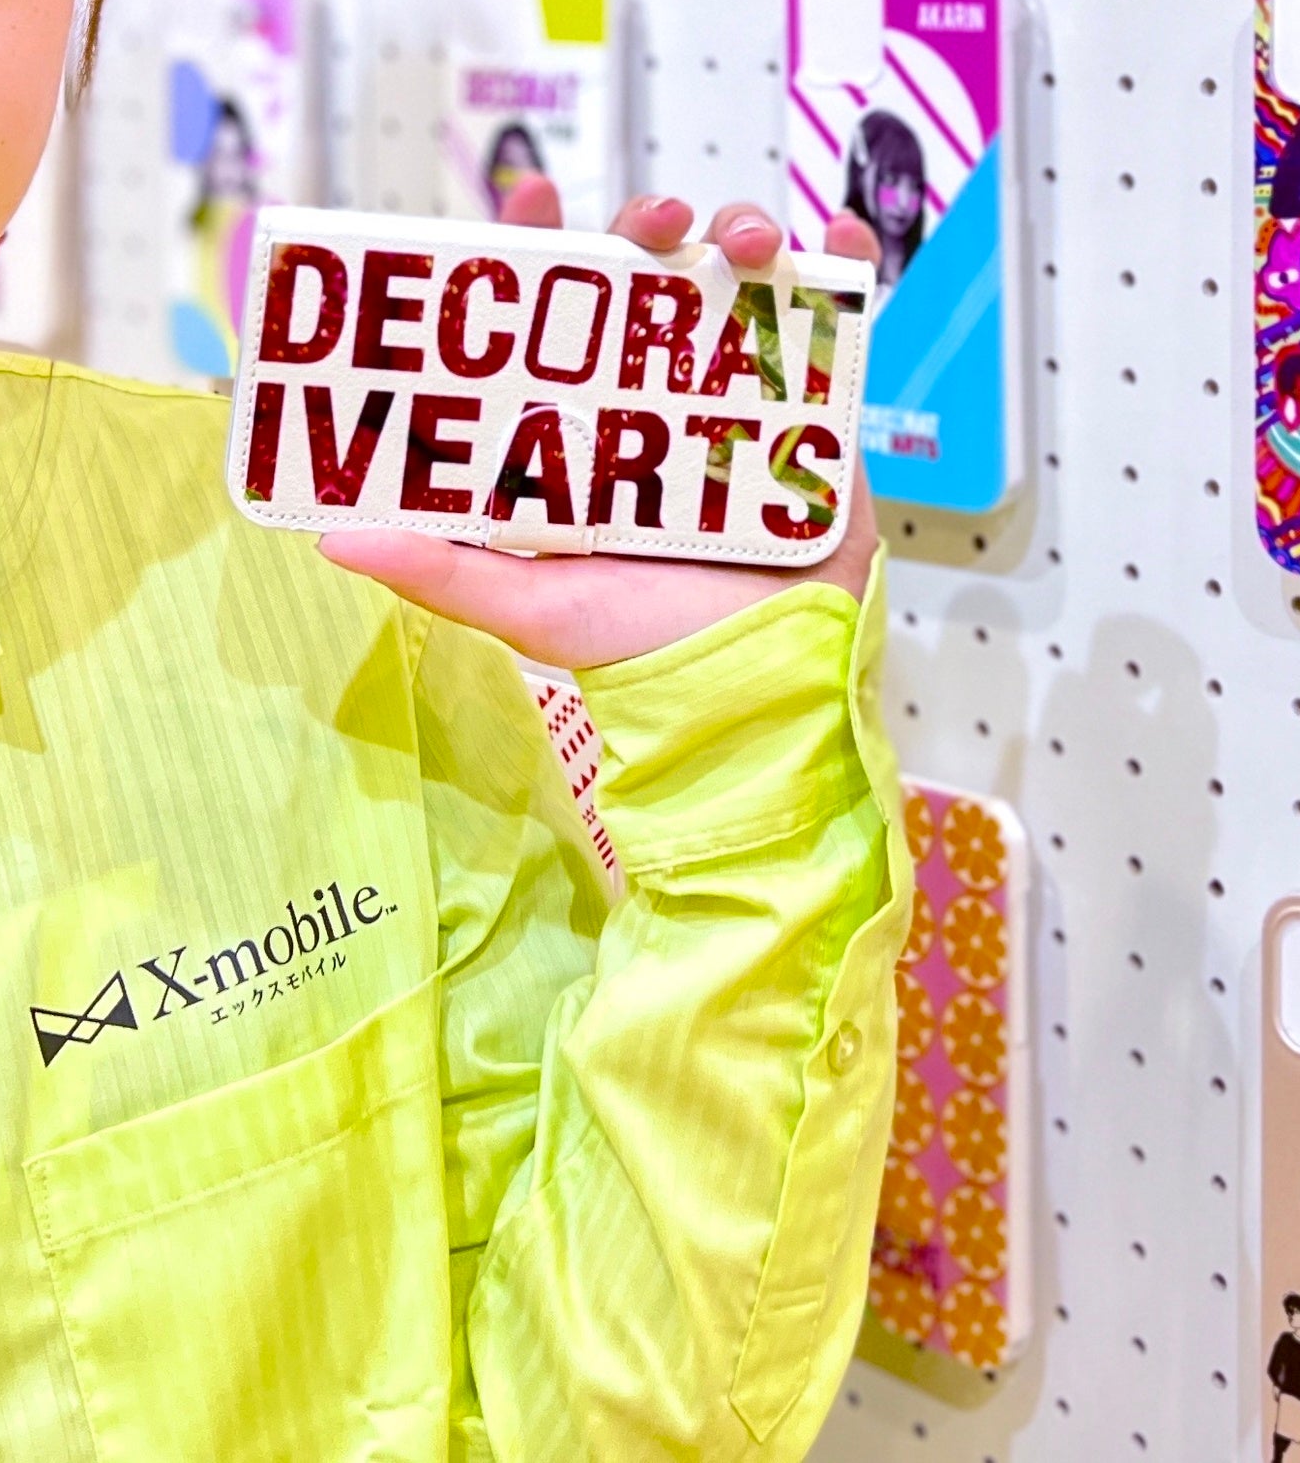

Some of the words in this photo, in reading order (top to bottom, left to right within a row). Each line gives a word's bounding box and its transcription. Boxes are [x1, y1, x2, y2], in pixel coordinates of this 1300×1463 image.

[917, 2, 986, 32] AKARIN
[258, 241, 867, 406] DECORAT
[243, 381, 842, 540] IVEARTS
[210, 951, 347, 1025] エックスモバイル
